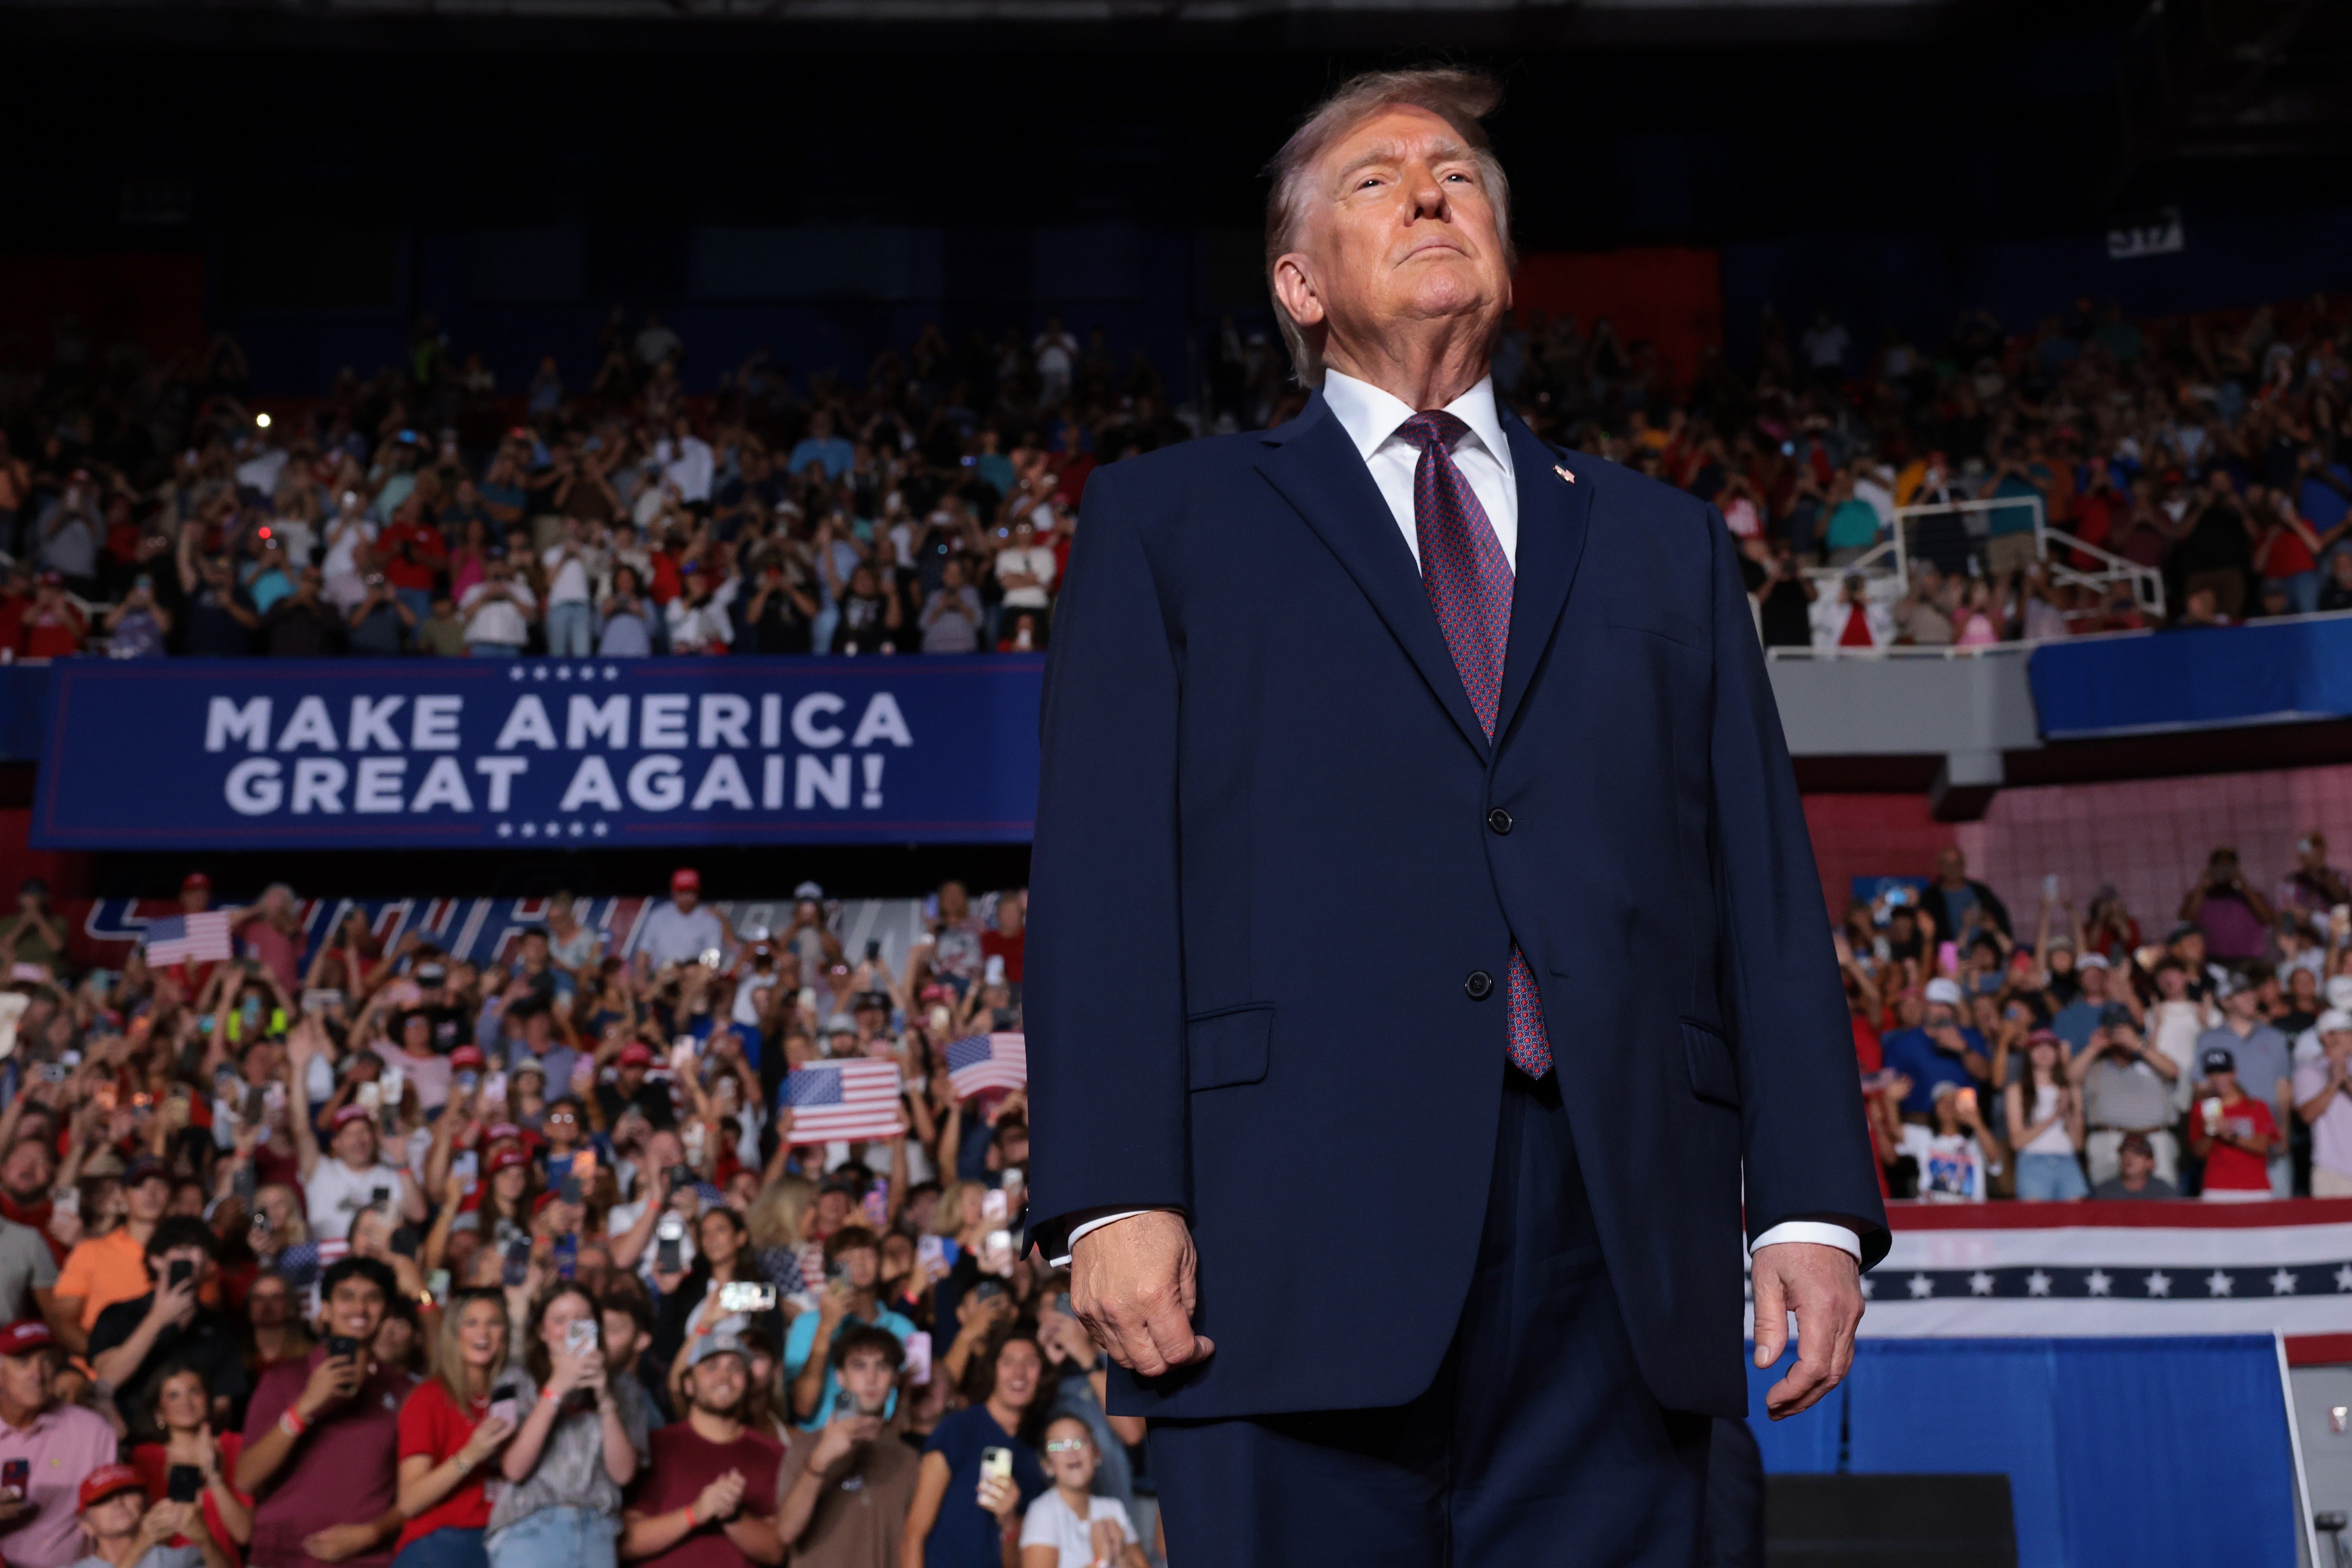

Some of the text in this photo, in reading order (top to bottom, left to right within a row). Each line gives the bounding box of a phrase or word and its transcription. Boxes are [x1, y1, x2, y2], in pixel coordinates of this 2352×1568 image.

[206, 693, 912, 751] MAKE AMERICA
[225, 754, 885, 814] GREAT AGAIN!
